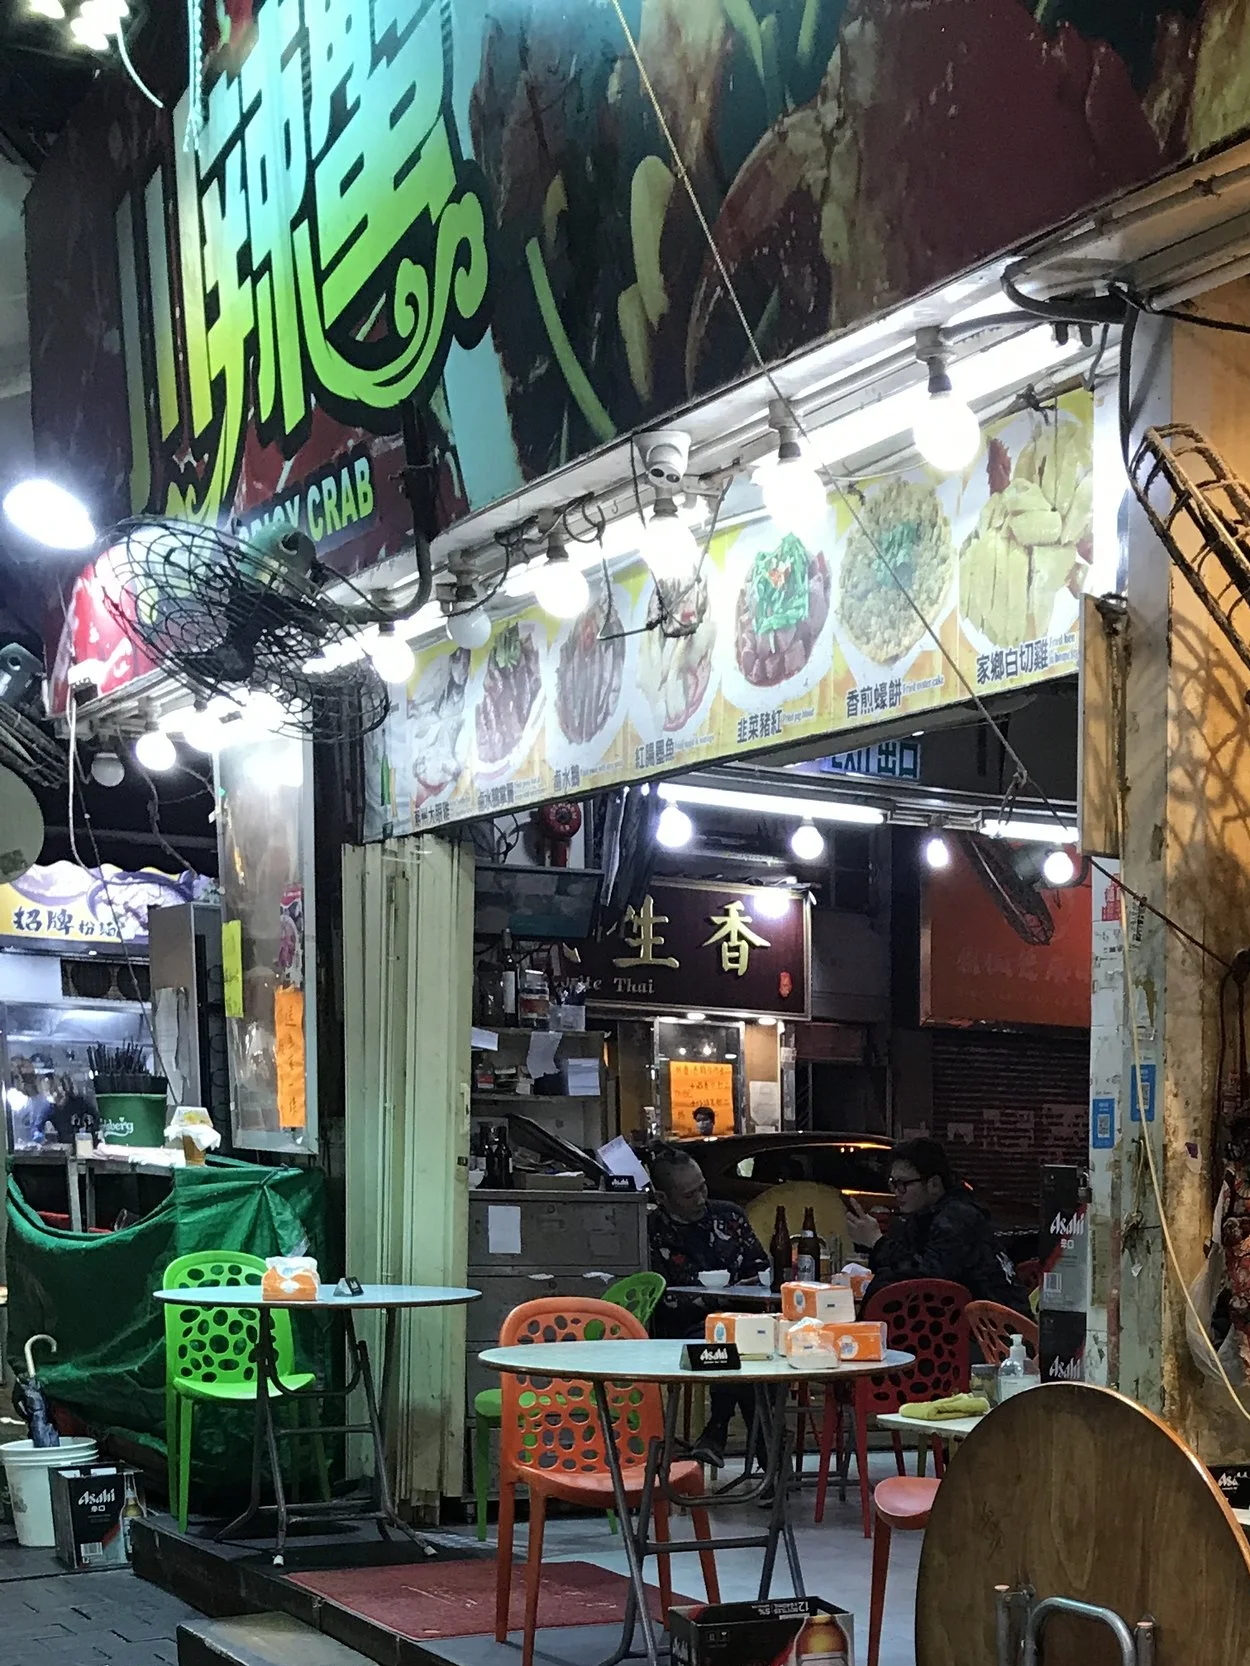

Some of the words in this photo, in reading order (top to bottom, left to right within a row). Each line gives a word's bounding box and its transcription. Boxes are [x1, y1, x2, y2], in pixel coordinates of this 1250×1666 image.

[307, 457, 373, 541] CRAB
[977, 639, 1048, 684] 家鄉白切雞
[877, 741, 918, 778] 出口
[614, 977, 655, 994] Thai
[1050, 1211, 1085, 1236] Asahi
[700, 1348, 728, 1360] Asahi
[1049, 1355, 1081, 1379] Asahi
[78, 1488, 115, 1505] Asahi
